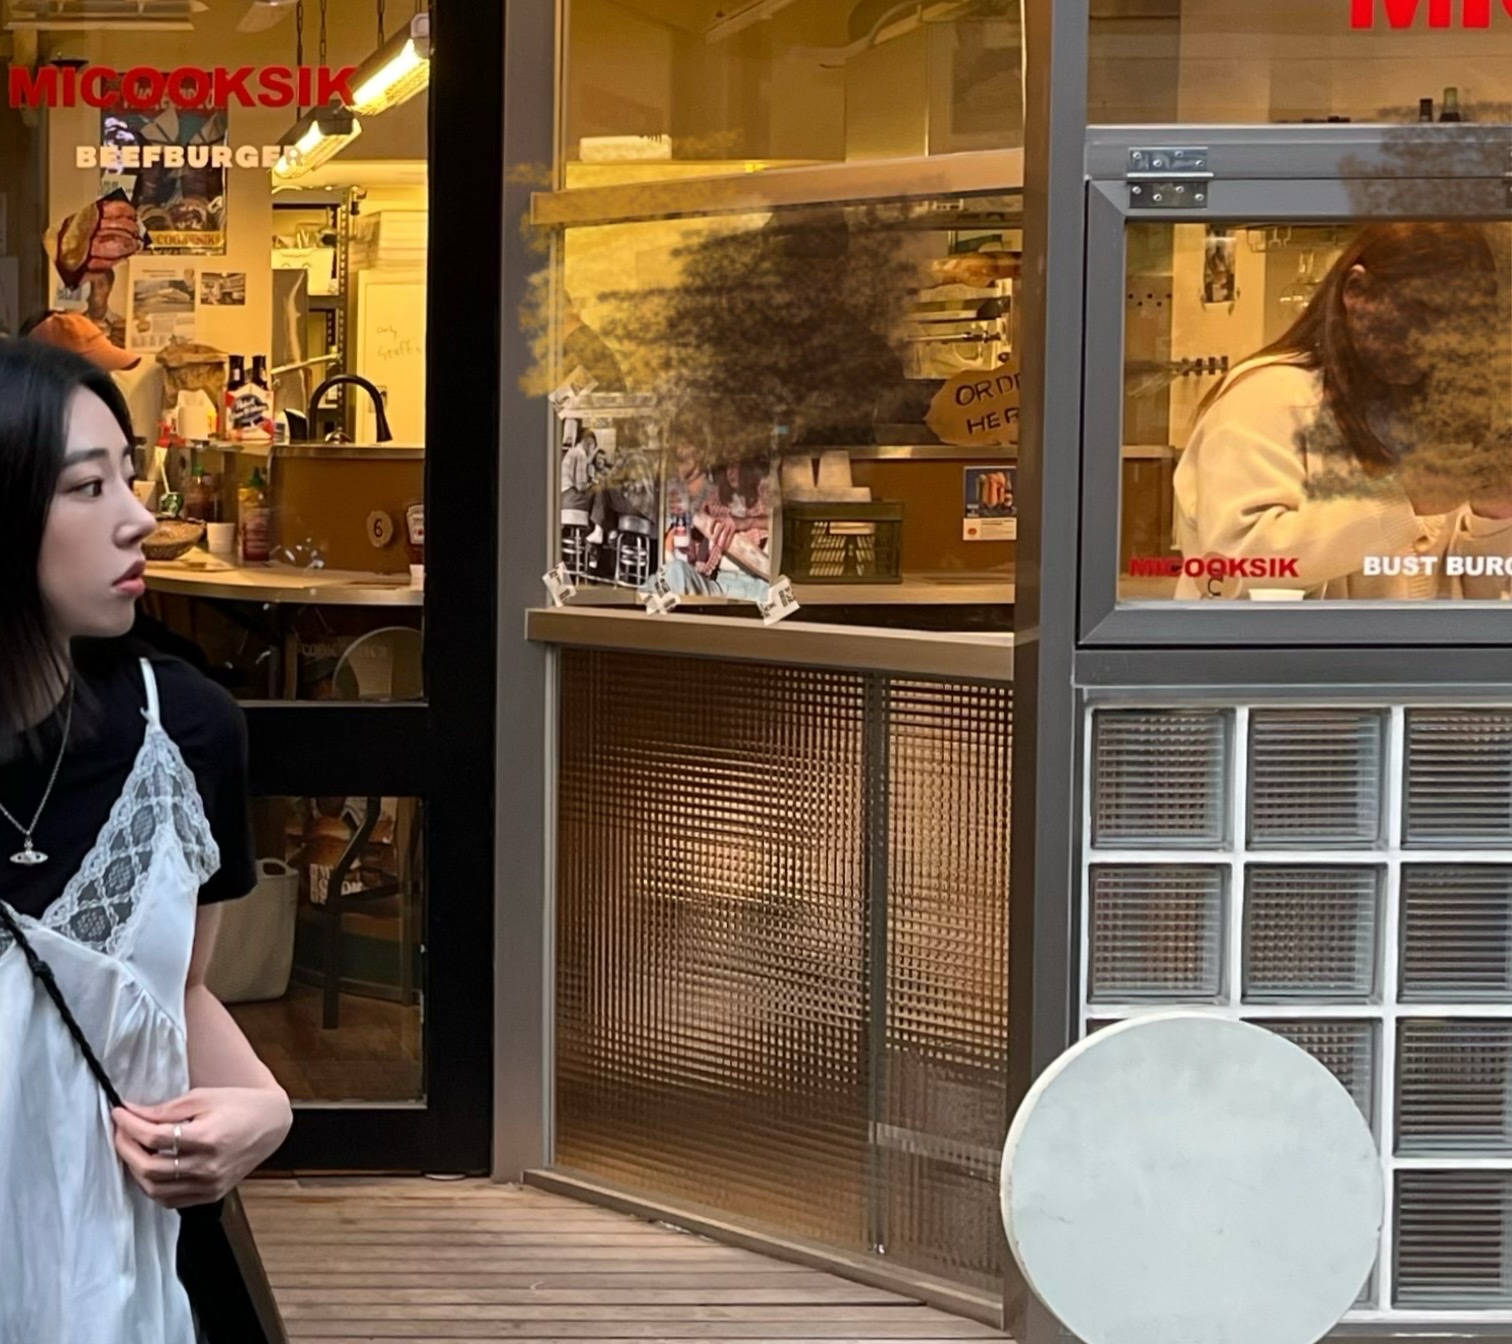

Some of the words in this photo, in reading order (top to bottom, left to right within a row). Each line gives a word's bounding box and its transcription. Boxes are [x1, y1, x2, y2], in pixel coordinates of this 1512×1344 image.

[9, 64, 361, 109] MICOOKSIK
[75, 144, 303, 168] BEEFBURGER
[372, 515, 385, 539] 6
[1129, 557, 1300, 578] MICOOKSIK
[1363, 556, 1438, 576] BUST
